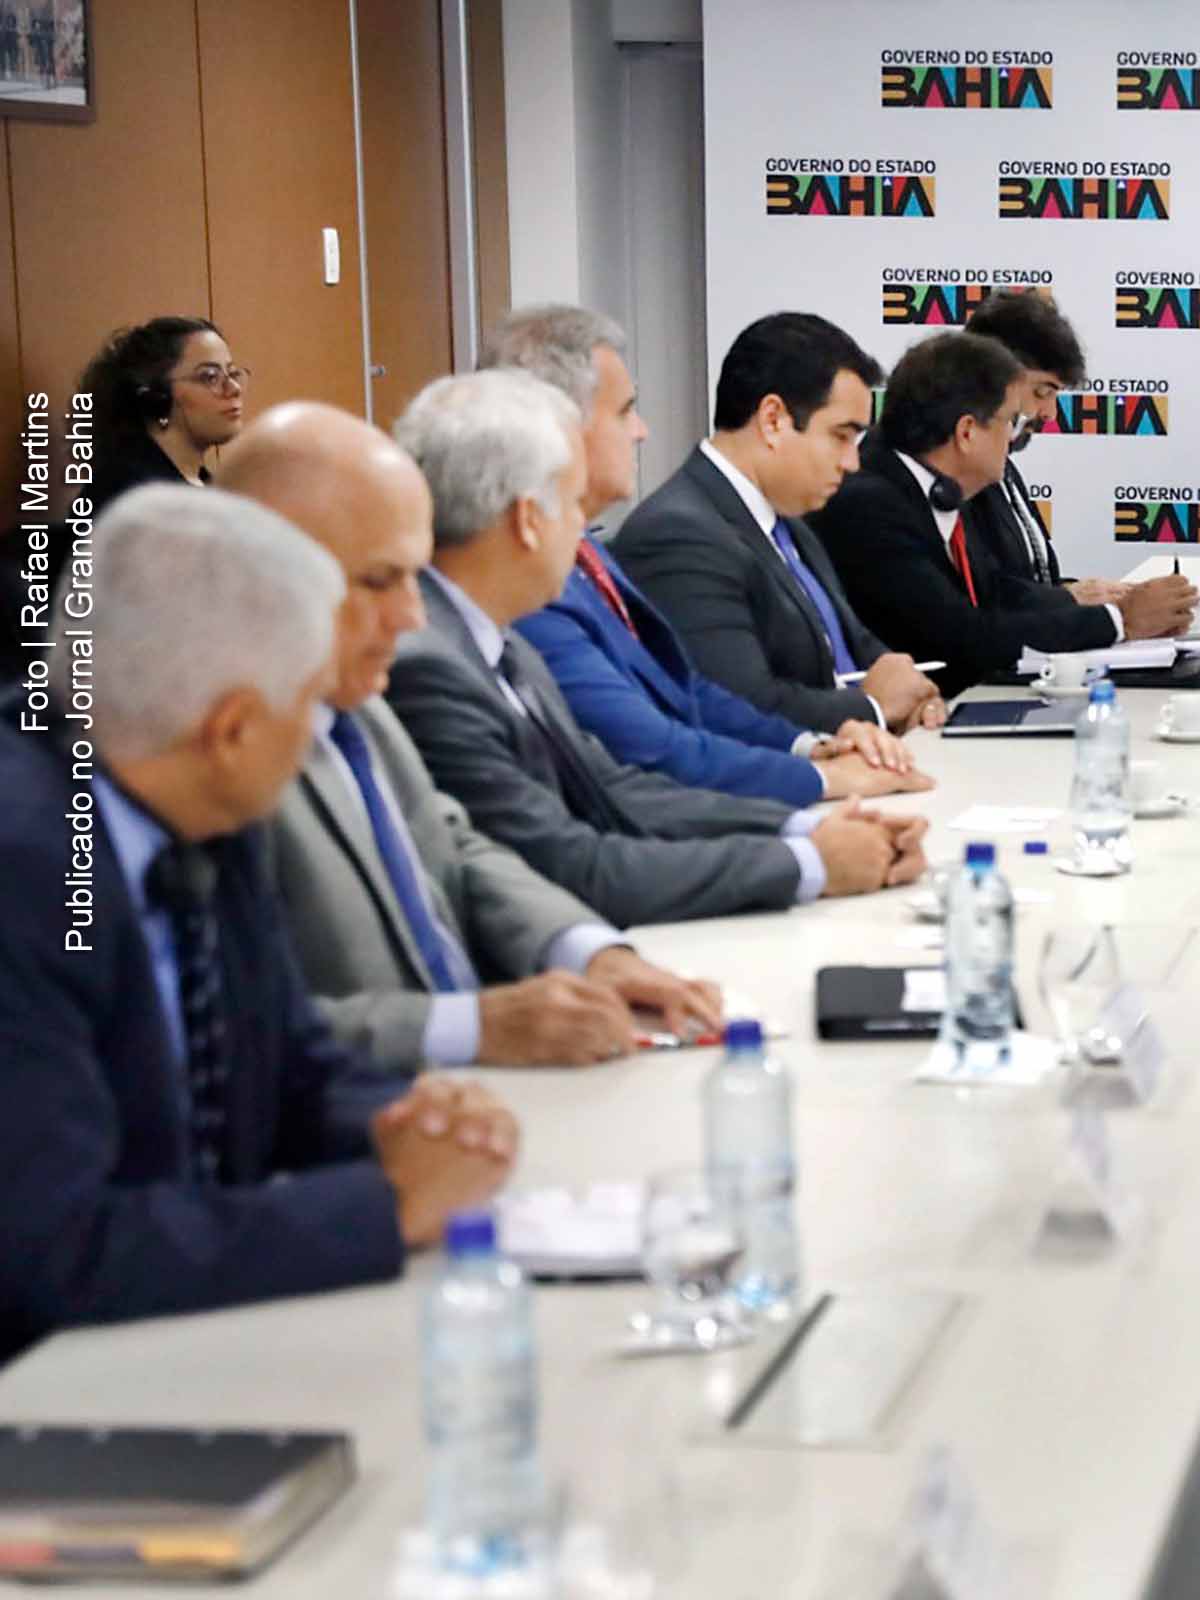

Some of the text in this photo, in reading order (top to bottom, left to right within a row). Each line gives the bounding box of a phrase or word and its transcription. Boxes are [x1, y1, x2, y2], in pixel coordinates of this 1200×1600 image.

[881, 50, 1053, 65] GOVERNO DO ESTADO
[1117, 52, 1197, 66] GOVERNO
[882, 67, 1052, 108] BAHIA
[766, 158, 936, 174] GOVERNO DO ESTADO
[999, 161, 1171, 176] GOVERNO DO ESTADO
[767, 176, 934, 216] BAHIA
[999, 179, 1168, 219] BAHIA
[883, 268, 1052, 284] GOVERNO DO ESTADO
[1116, 271, 1194, 285] GOVERNO
[1109, 379, 1168, 393] ESTADO
[1114, 486, 1193, 501] GOVERNO
